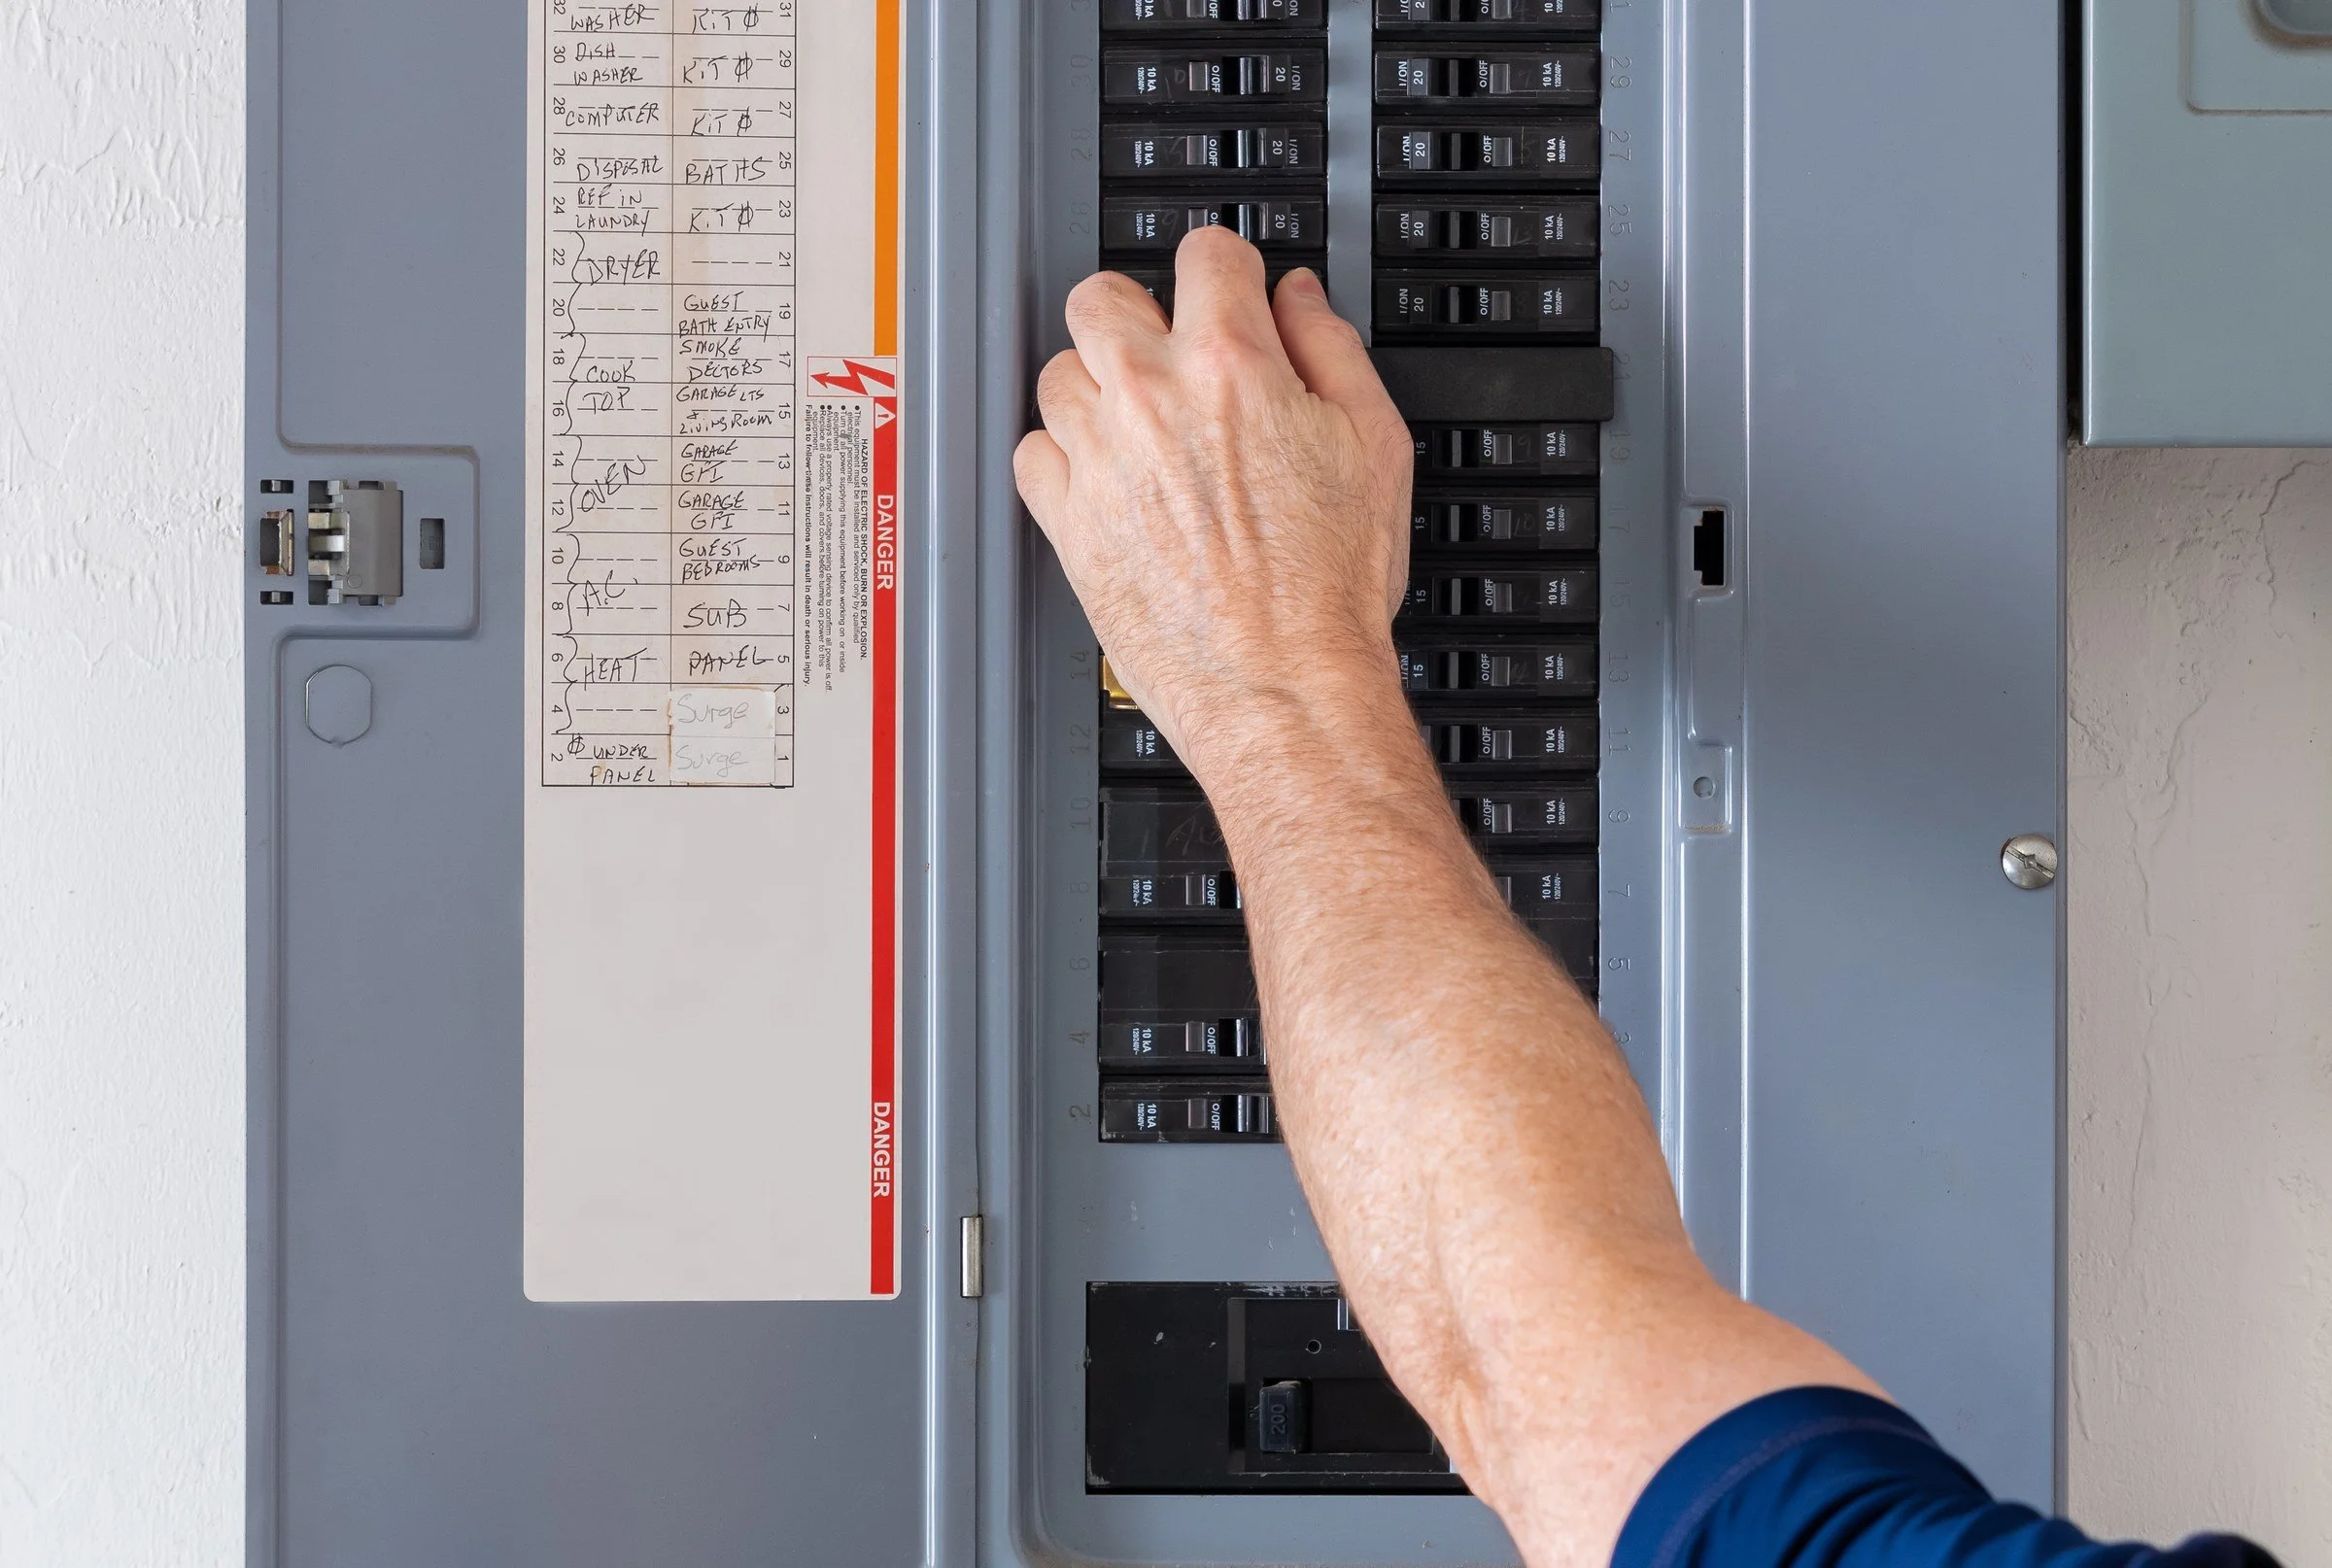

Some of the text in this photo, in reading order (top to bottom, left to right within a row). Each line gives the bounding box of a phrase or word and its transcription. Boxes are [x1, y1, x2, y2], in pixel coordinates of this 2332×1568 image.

[779, 2, 792, 20] 31
[553, 46, 566, 64] 30
[779, 50, 792, 68] 29
[1147, 67, 1156, 92] 10 kA
[1212, 65, 1220, 93] O/OFF
[1275, 67, 1286, 82] 20
[1414, 70, 1423, 85] 20
[1479, 59, 1488, 87] O/OFF
[1543, 61, 1552, 87] 10 kA
[553, 97, 566, 116] 28
[778, 101, 792, 119] 27
[1145, 141, 1153, 166] 10 kA
[1209, 139, 1217, 167] O/OFF
[1272, 140, 1283, 155] 20
[1416, 142, 1425, 157] 20
[1547, 137, 1556, 162] 10 kA
[553, 148, 566, 166] 26
[778, 152, 792, 170] 25
[553, 197, 565, 215] 24
[778, 200, 791, 219] 23
[1147, 213, 1155, 238] 10 kA
[1275, 214, 1286, 229] 20
[1414, 222, 1423, 236] 20
[1481, 212, 1490, 240] O/OFF
[1545, 215, 1554, 240] 10 kA
[552, 249, 565, 266] 22
[778, 252, 791, 268] 21
[552, 298, 565, 317] 20
[778, 303, 791, 320] 19
[1414, 297, 1423, 312] 20
[552, 349, 565, 365] 18
[778, 352, 791, 367] 17
[552, 401, 565, 417] 16
[778, 403, 791, 420] 15
[1417, 441, 1425, 455] 15
[1484, 429, 1492, 457] O/OFF
[552, 451, 565, 467] 14
[778, 453, 791, 470] 13
[861, 476, 868, 487] OF
[854, 490, 861, 498] be
[551, 499, 564, 516] 12
[777, 501, 791, 517] 11
[876, 494, 894, 590] DANGER
[551, 548, 564, 564] 10
[777, 556, 790, 564] 9
[551, 601, 564, 611] 8
[777, 602, 790, 612] 7
[861, 595, 868, 606] OR
[551, 653, 564, 663] 6
[777, 655, 790, 664] 5
[1414, 664, 1423, 677] 15
[1545, 655, 1554, 680] 10 kA
[551, 704, 564, 713] 4
[777, 705, 789, 715] 3
[551, 753, 564, 762] 2
[1484, 798, 1492, 826] O/OFF
[1143, 1028, 1151, 1053] 10 kA
[1207, 1027, 1216, 1054] O/OFF
[1148, 1103, 1156, 1128] 10 kA
[1212, 1103, 1220, 1131] O/OFF
[874, 1102, 890, 1198] DANGER
[1271, 1403, 1287, 1436] 200
